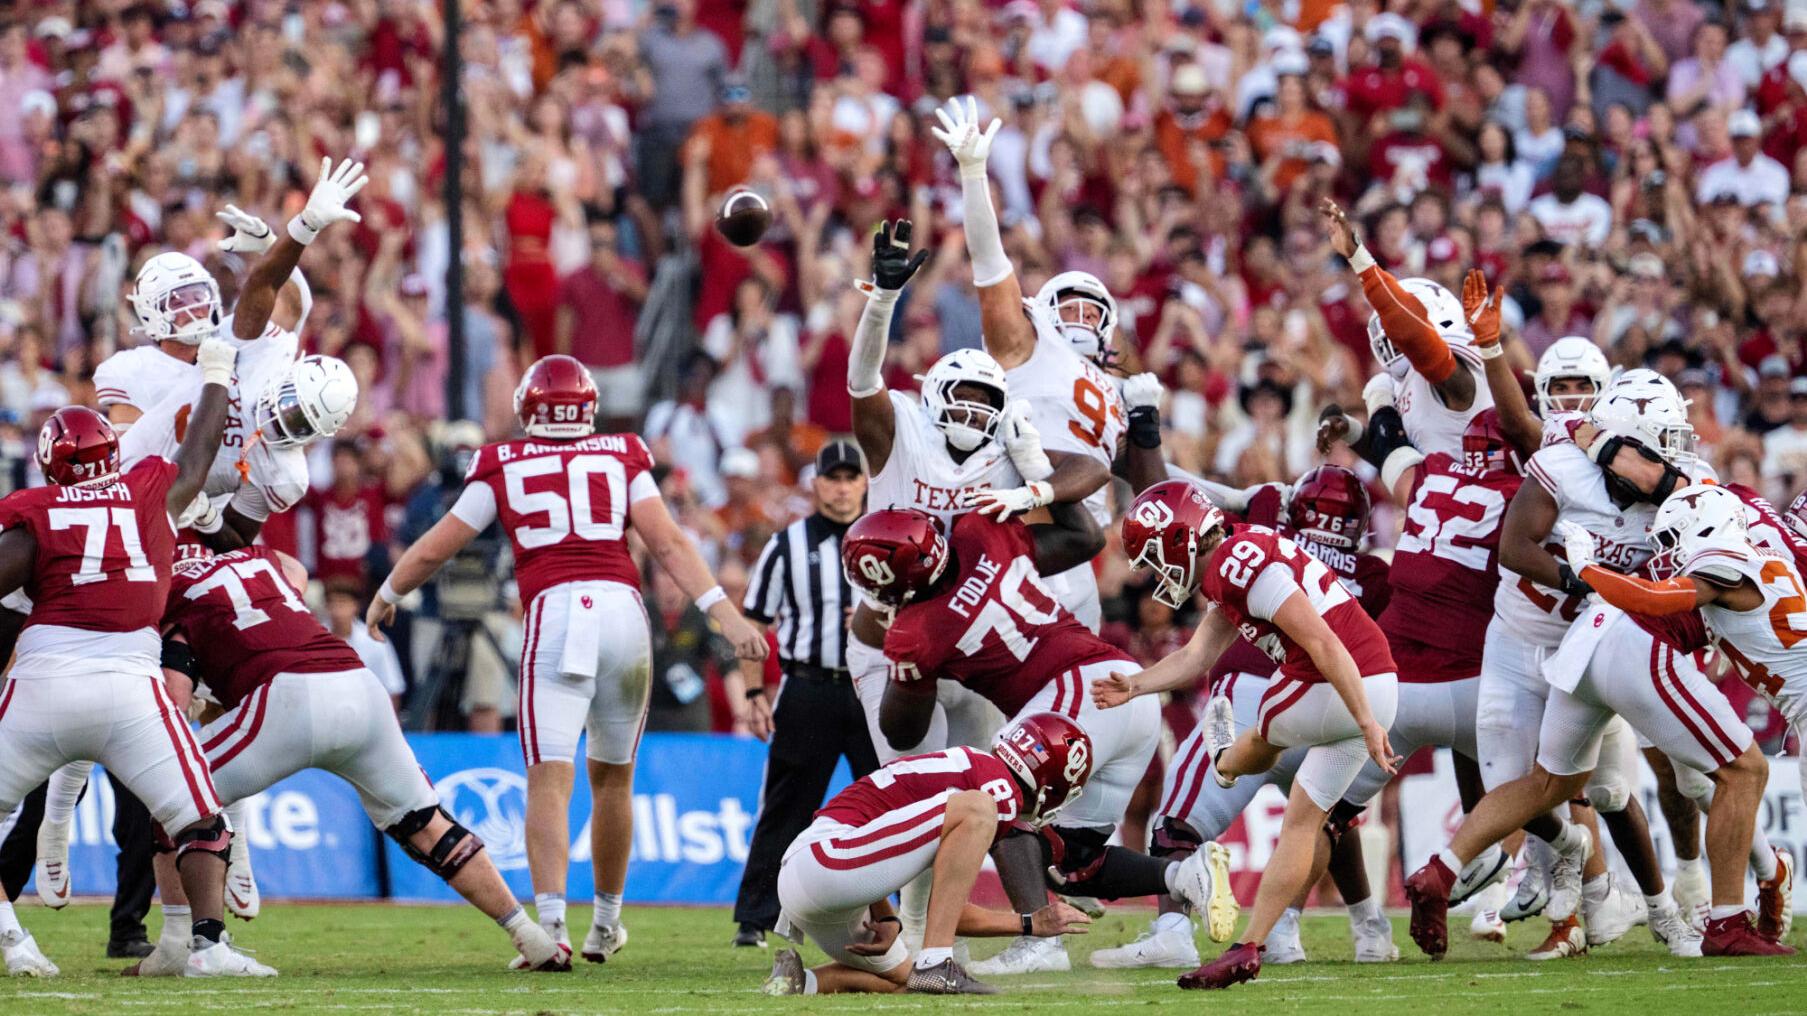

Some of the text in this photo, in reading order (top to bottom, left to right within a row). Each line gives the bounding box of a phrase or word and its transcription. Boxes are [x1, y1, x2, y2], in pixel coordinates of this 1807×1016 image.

[553, 404, 578, 421] 50
[84, 459, 107, 478] 71
[497, 445, 517, 462] B.
[1464, 451, 1485, 468] 52
[55, 482, 132, 503] JOSEPH
[502, 454, 628, 550] 50
[913, 477, 992, 511] TEX
[1317, 512, 1343, 532] 76
[1395, 473, 1506, 572] 52
[47, 506, 158, 587] 71
[177, 543, 202, 560] 77
[1219, 540, 1266, 589] 29
[1293, 533, 1357, 575] HARRIS
[1586, 529, 1637, 568] XAS
[183, 558, 311, 631] 77
[947, 552, 1002, 618] FODJE
[954, 553, 1060, 663] 70
[1011, 727, 1036, 752] 87
[980, 777, 1018, 822] 87
